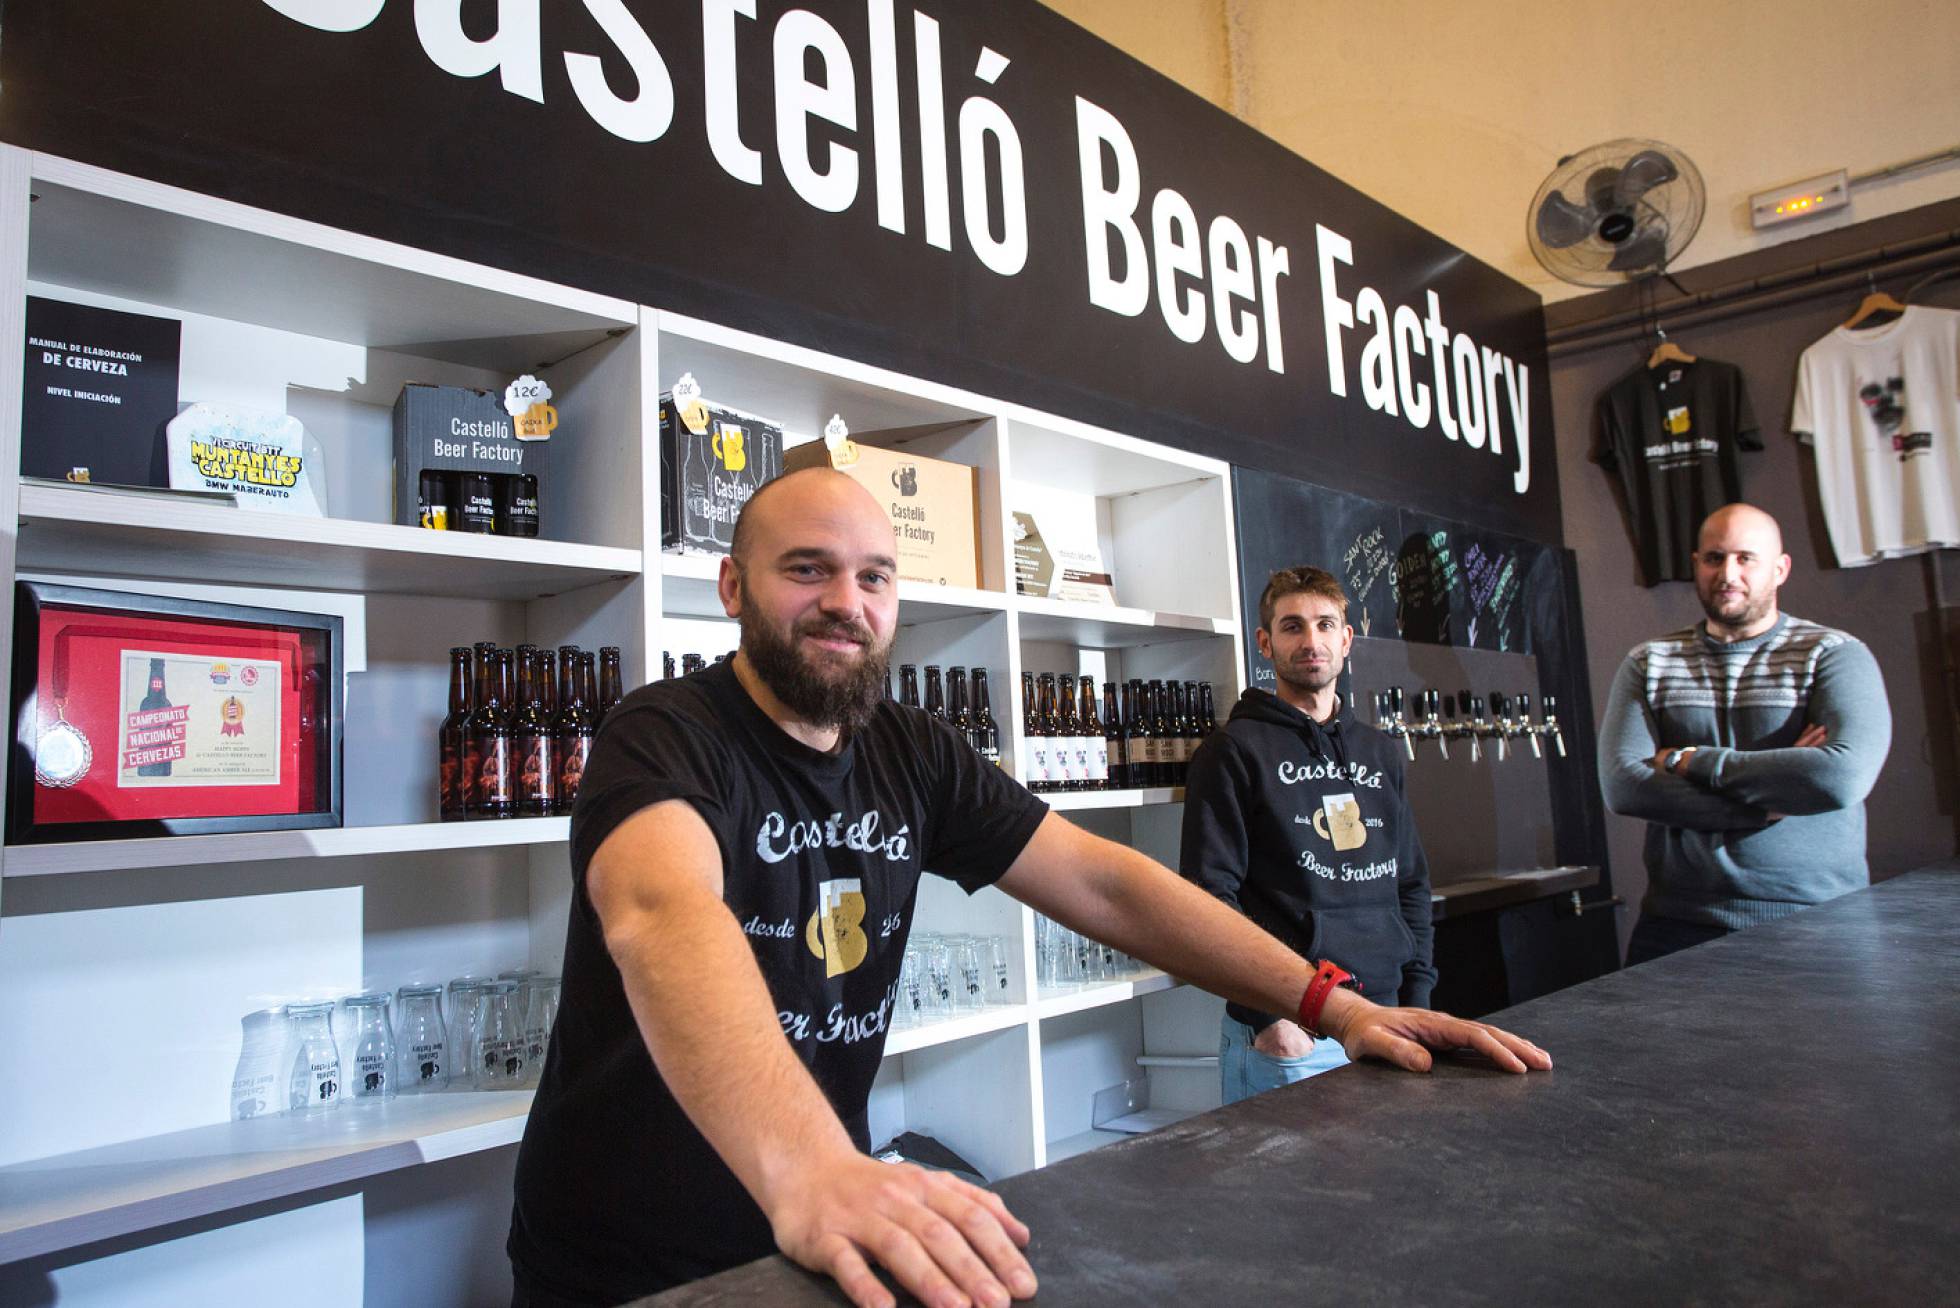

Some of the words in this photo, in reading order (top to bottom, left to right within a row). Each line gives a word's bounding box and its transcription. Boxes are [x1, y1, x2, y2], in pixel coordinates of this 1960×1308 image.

[1074, 95, 1289, 375] Beer
[1315, 223, 1531, 494] Factory
[29, 336, 67, 350] MANUAL
[70, 343, 81, 353] DE
[83, 344, 142, 363] ELABORACIÓN
[42, 351, 62, 366] DE
[66, 355, 128, 377] CERVEZA
[47, 386, 72, 398] NIVEL
[74, 388, 121, 404] INICIACIÓN
[513, 385, 539, 398] 12€
[450, 417, 509, 439] Castelló
[191, 440, 303, 474] MUNTANYES
[433, 438, 468, 458] Beer
[472, 441, 524, 465] Factory
[703, 498, 730, 523] Beer
[891, 502, 926, 522] Castelló
[904, 523, 935, 544] Factory
[129, 709, 185, 727] CAMPEONATO
[130, 730, 177, 747] NACIONAL
[128, 746, 181, 767] CERVEZAS
[1297, 850, 1337, 881] Beer
[1341, 857, 1399, 883] Factory
[744, 915, 796, 939] desde
[778, 1011, 810, 1041] er
